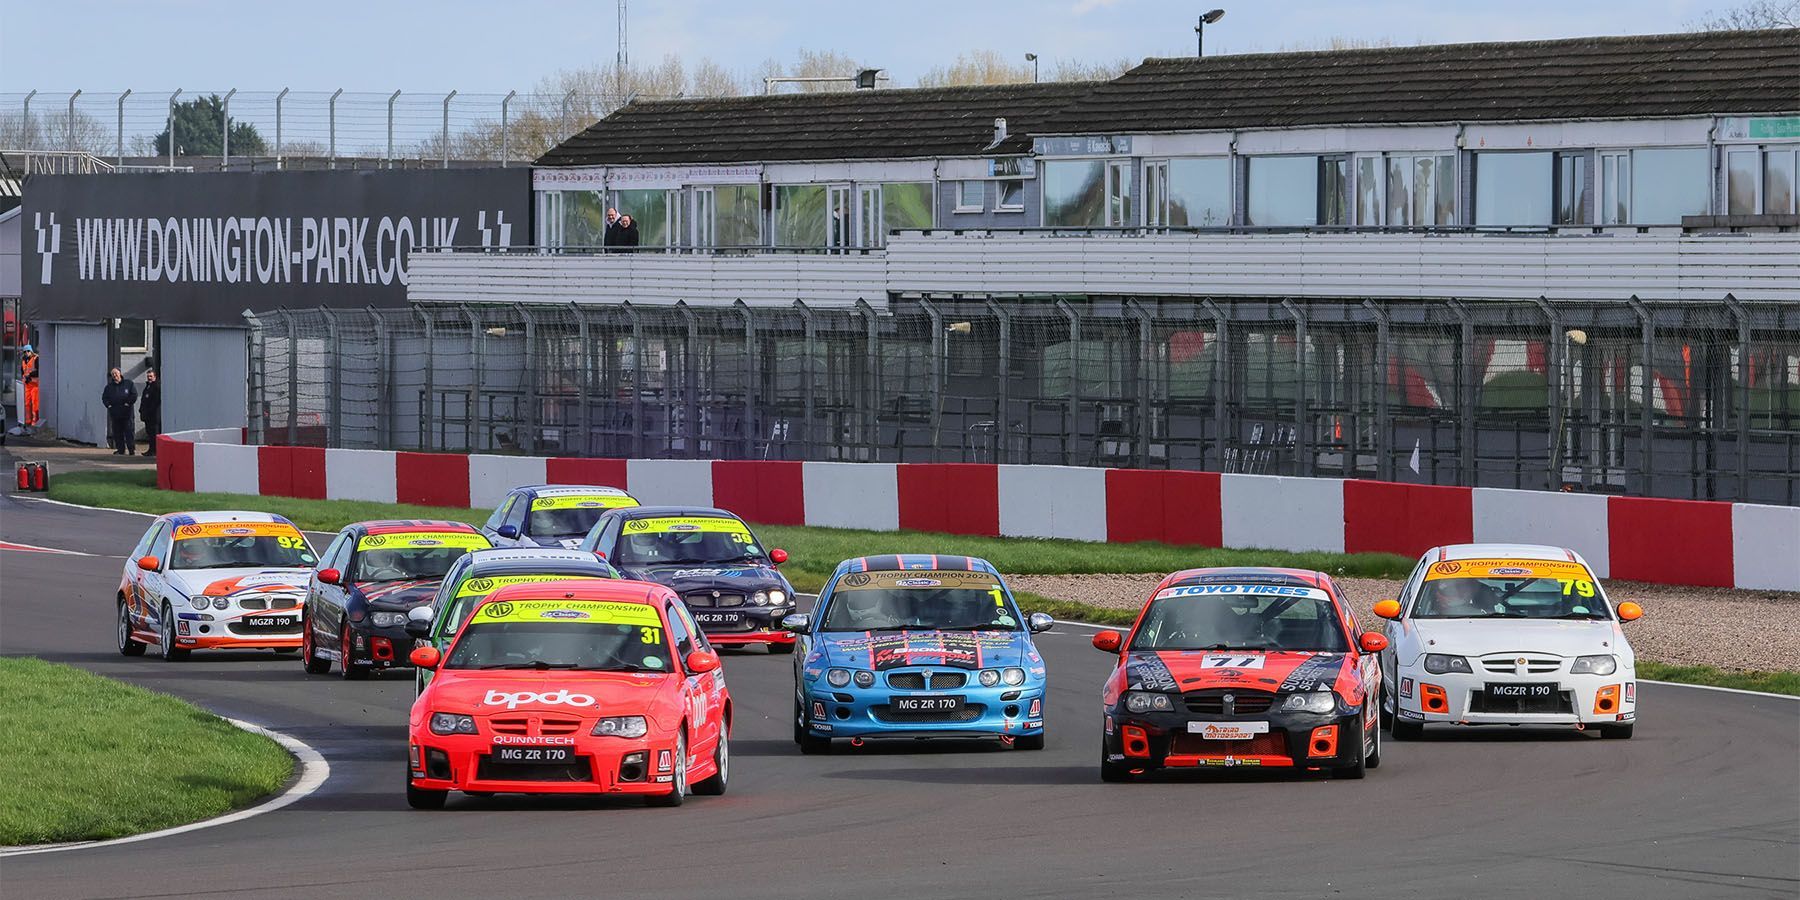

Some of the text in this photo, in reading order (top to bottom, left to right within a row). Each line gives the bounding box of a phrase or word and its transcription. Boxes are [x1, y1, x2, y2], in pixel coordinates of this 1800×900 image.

[277, 536, 306, 550] 92
[1435, 562, 1462, 575] MG
[1506, 561, 1578, 569] CHAMPIONSHIP
[468, 579, 494, 592] MG
[844, 574, 871, 587] MG
[1175, 585, 1310, 596] TOYO TIRES
[1557, 578, 1595, 598] 79
[987, 589, 1004, 607] 1
[485, 602, 513, 618] MG
[566, 603, 648, 613] CHAMPIONSHIP
[249, 618, 274, 626] MGZR
[695, 614, 710, 622] MG
[640, 627, 660, 645] 31
[1493, 686, 1550, 696] MGZR 190
[483, 689, 596, 709] bpdo
[899, 699, 956, 709] MG ZR 170
[493, 735, 574, 745] QUINNTECH
[501, 749, 566, 760] MG ZR 170
